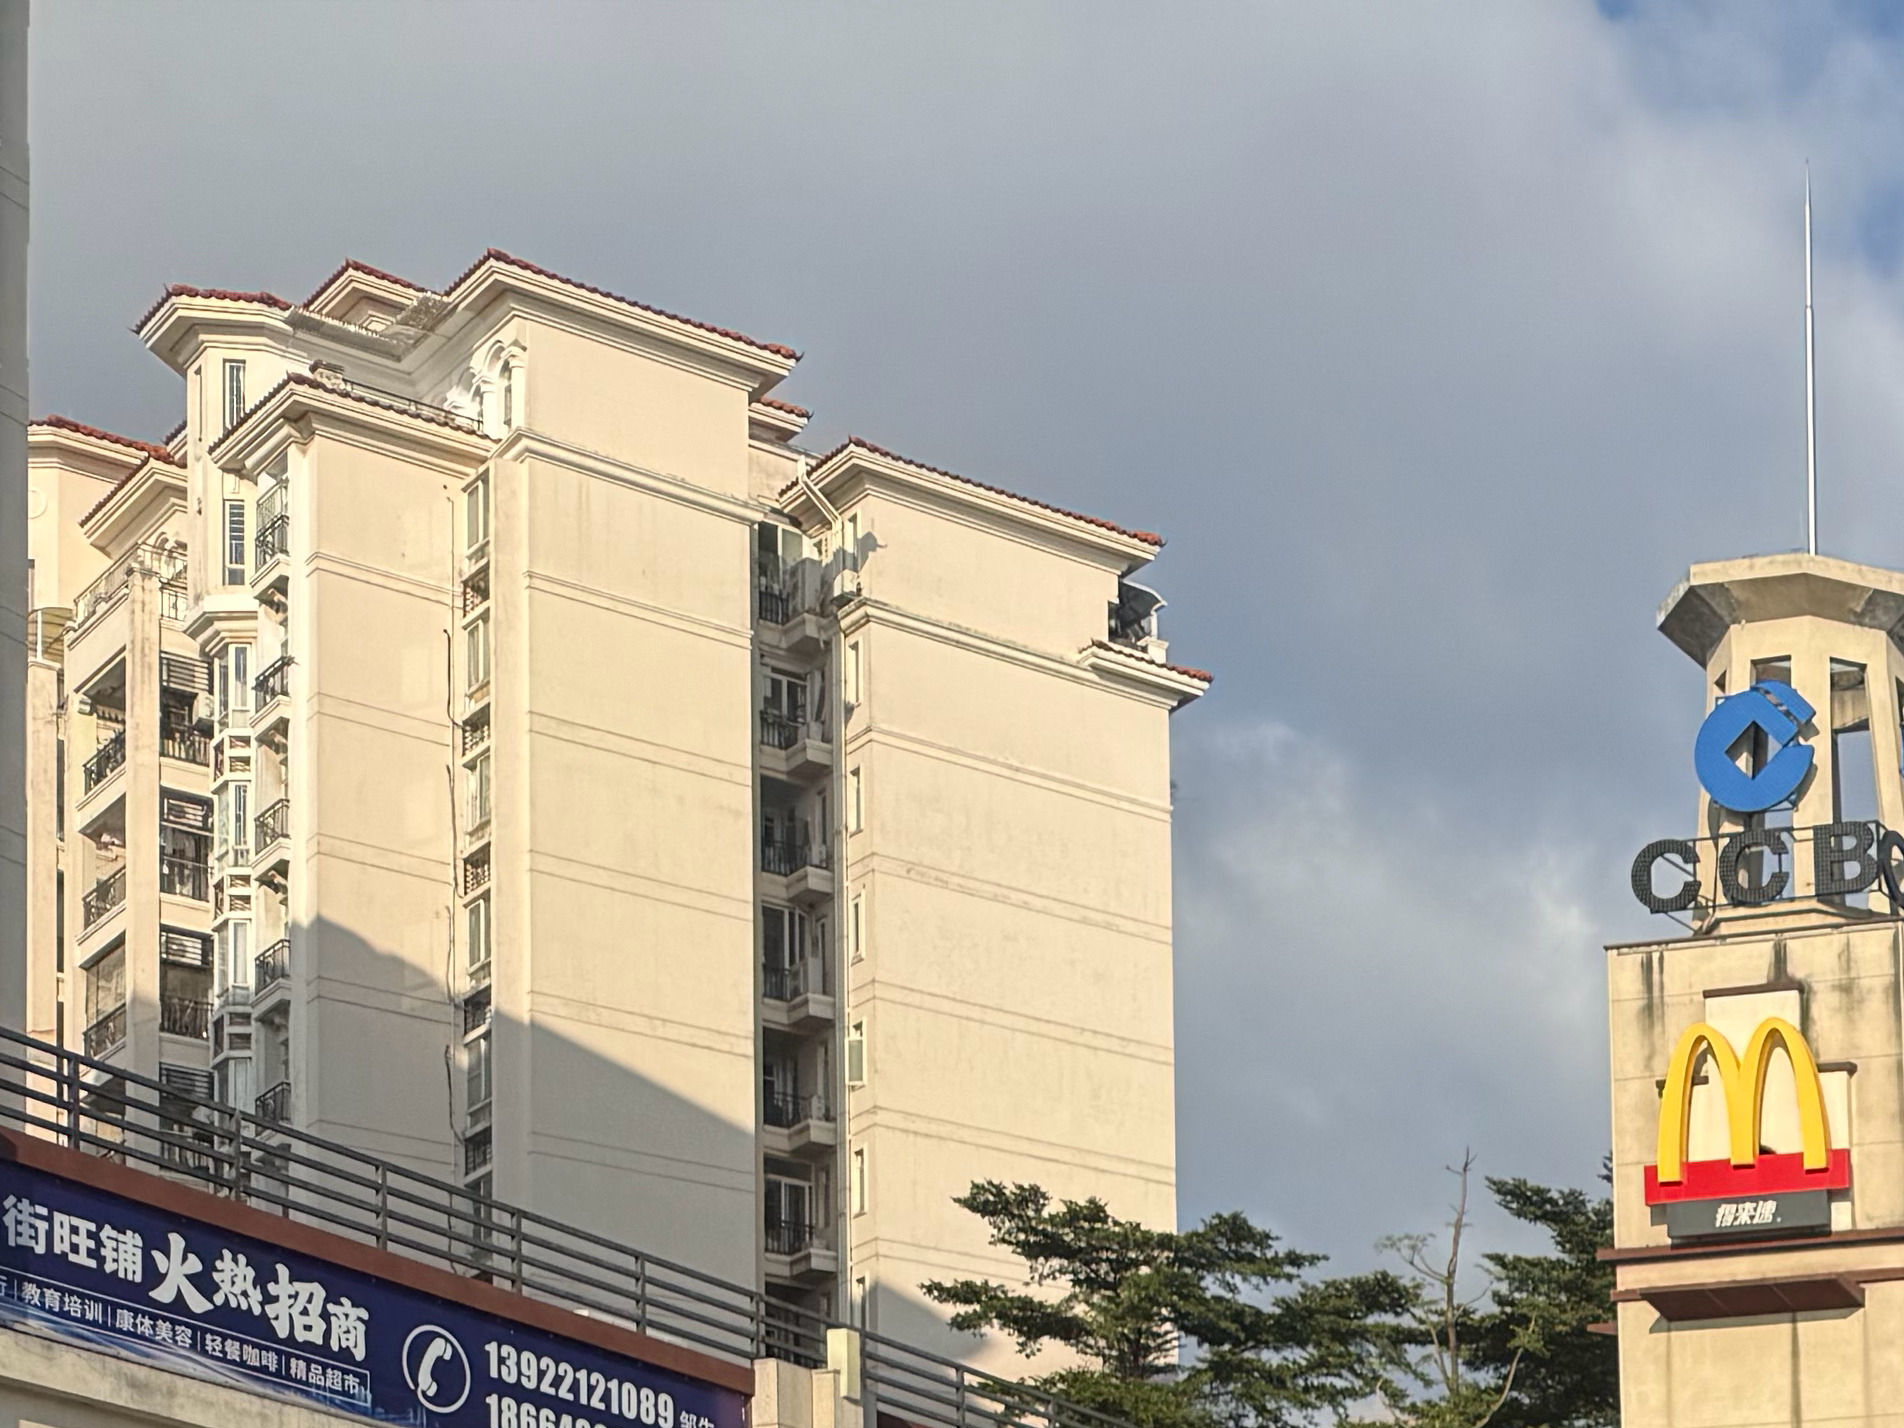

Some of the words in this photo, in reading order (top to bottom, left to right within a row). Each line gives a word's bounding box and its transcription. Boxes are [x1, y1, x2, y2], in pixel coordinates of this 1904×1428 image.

[1631, 821, 1879, 913] CCB
[3, 1195, 143, 1283] 街旺铺
[148, 1233, 369, 1361] 火热招商
[22, 1282, 103, 1322] 教育培训
[116, 1308, 193, 1348] 康体美容
[205, 1333, 278, 1373] 轻餐咖啡
[290, 1357, 361, 1395] 精品超市
